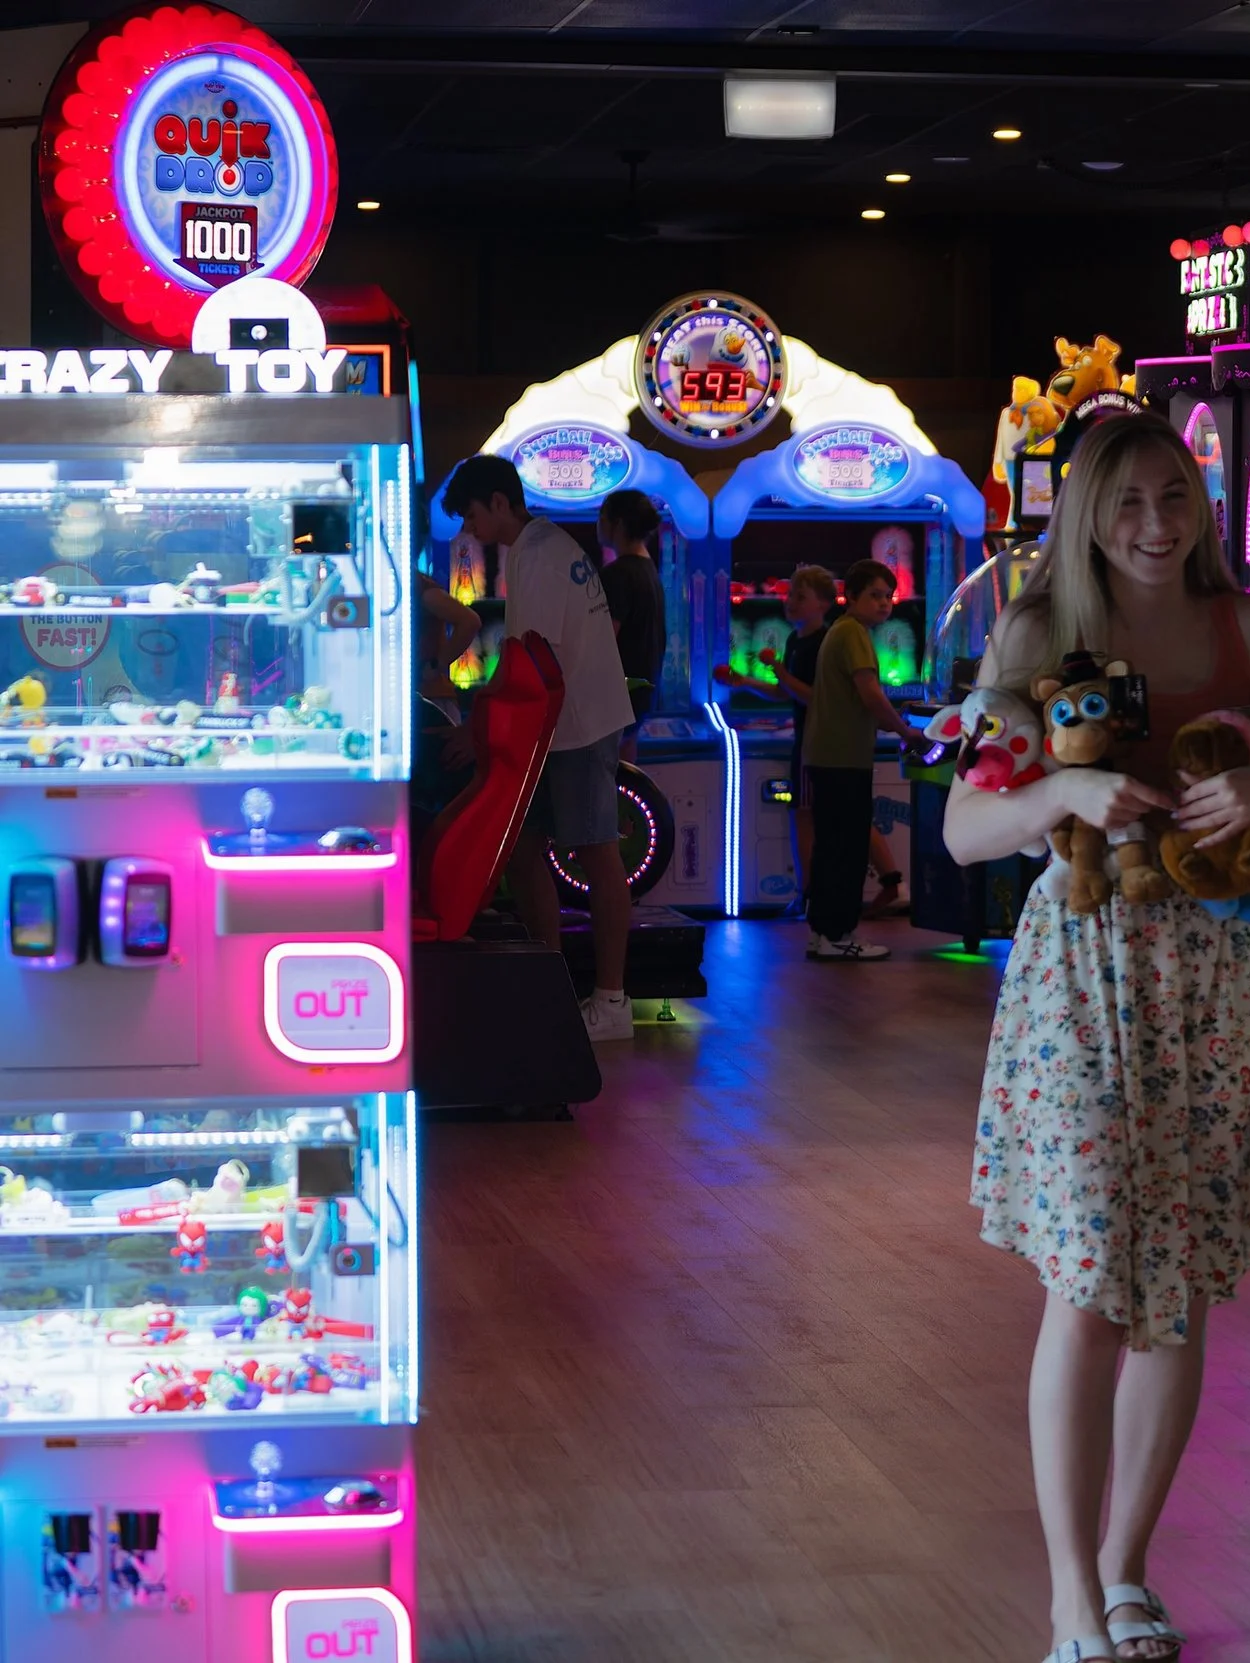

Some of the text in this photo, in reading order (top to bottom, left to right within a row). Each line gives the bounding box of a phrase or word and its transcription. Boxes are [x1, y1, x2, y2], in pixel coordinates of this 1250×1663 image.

[154, 100, 271, 168] QUIK
[156, 155, 273, 196] DROP
[195, 206, 245, 219] JACKPOT
[186, 220, 252, 261] 1000
[198, 263, 241, 275] TICKETS
[0, 349, 348, 394] RAZY TOY
[682, 372, 745, 400] 593
[1075, 398, 1098, 420] MEGA
[1098, 393, 1126, 408] BONUS
[548, 464, 583, 479] 500
[829, 464, 863, 479] 500
[37, 628, 97, 647] FAST!
[293, 990, 369, 1019] OUT
[305, 1629, 380, 1660] OUT
